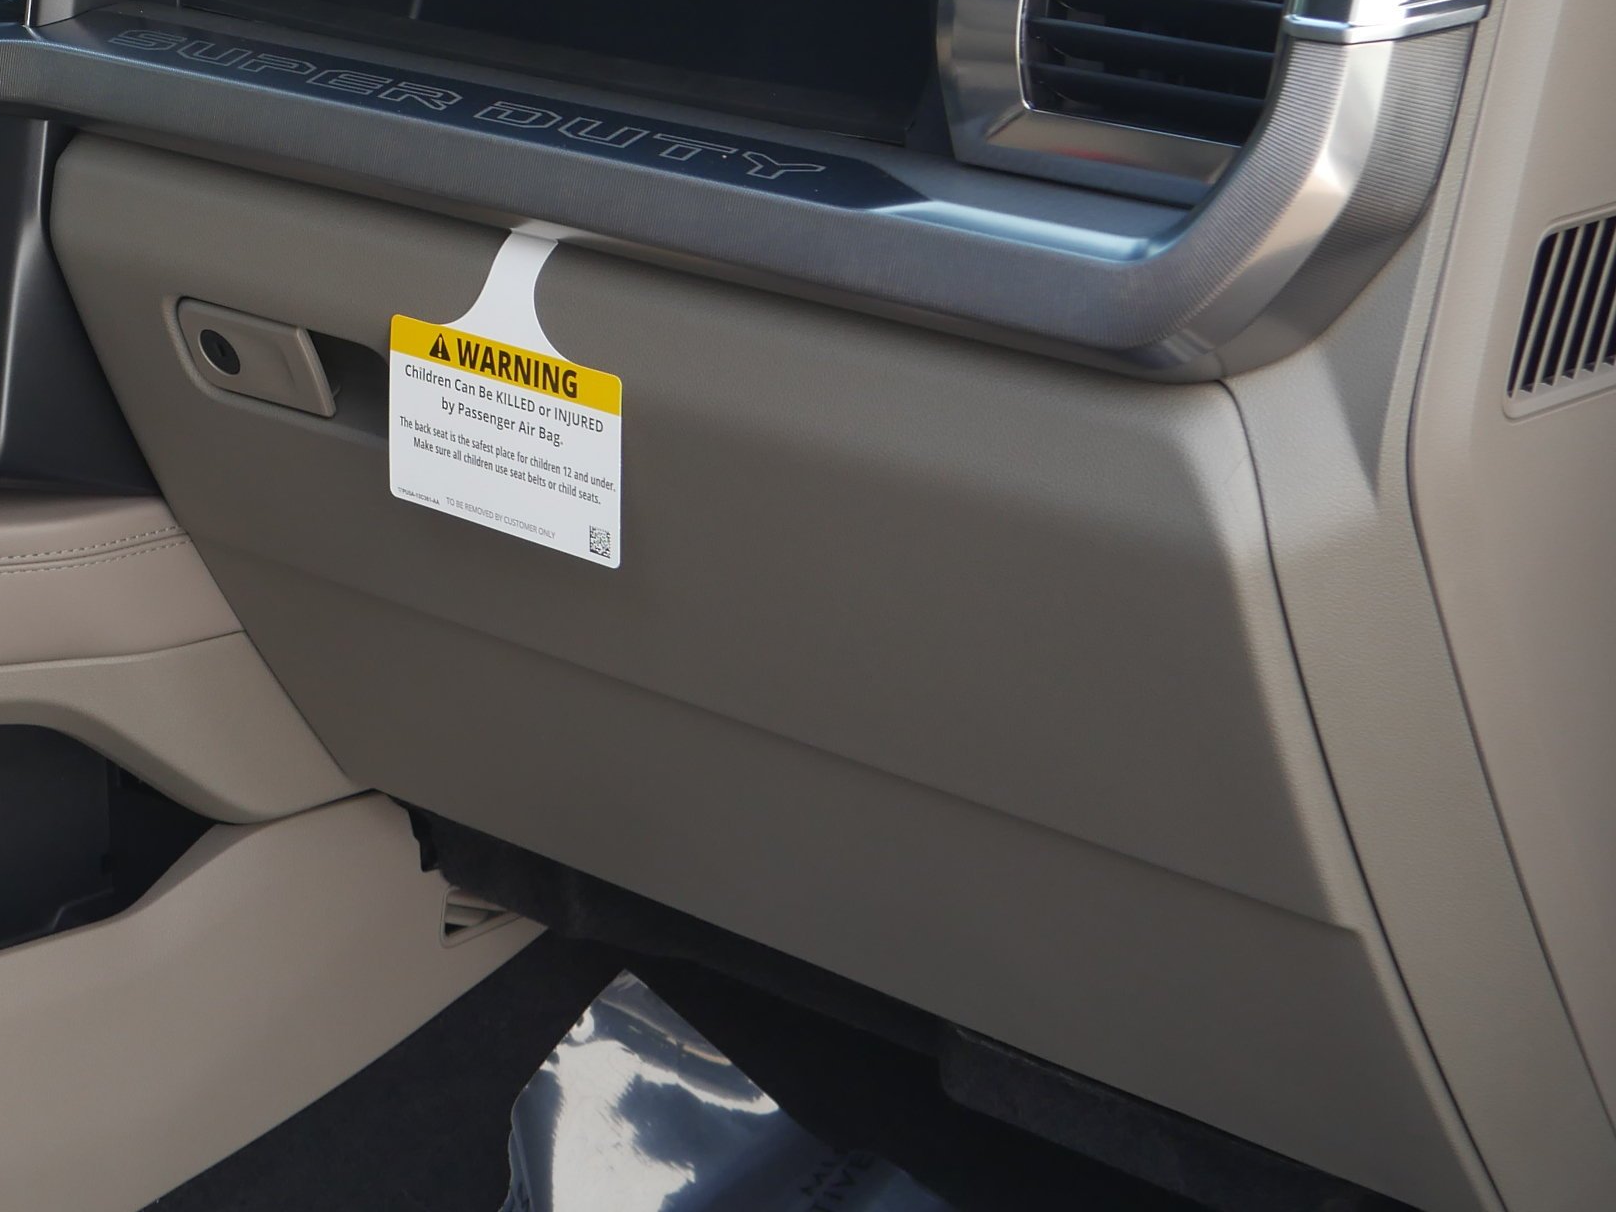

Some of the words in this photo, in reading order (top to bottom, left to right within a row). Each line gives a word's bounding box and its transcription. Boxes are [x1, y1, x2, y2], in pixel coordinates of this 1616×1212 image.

[108, 26, 463, 112] SUPER
[472, 97, 827, 182] DUTY
[404, 364, 451, 389] Children
[454, 378, 476, 396] Can
[479, 385, 493, 401] Be
[496, 390, 535, 413] KILLED
[538, 405, 551, 418] or
[554, 407, 604, 433] INJURED
[456, 337, 578, 399] WARNING
[400, 415, 413, 429] The
[414, 420, 432, 435] back
[433, 427, 449, 441] seat
[450, 431, 456, 443] is
[457, 434, 471, 448] the
[472, 439, 494, 455] safest
[495, 446, 516, 462] place
[517, 451, 528, 464] for
[530, 456, 561, 475] children
[563, 466, 573, 479] 12
[574, 469, 589, 484] and
[590, 477, 616, 493] under.
[441, 396, 455, 416] by
[458, 402, 516, 431] Passenger
[518, 420, 536, 437] Air
[538, 426, 564, 448] Bag.
[413, 436, 434, 453] Make
[435, 444, 451, 458] sure
[453, 450, 462, 462] all
[463, 453, 494, 472] children
[495, 463, 508, 477] use
[510, 467, 526, 482] seat
[527, 471, 546, 488] belts
[547, 480, 557, 491] or
[558, 481, 577, 498] child
[578, 489, 601, 506] seats.
[446, 496, 455, 507] TO
[455, 499, 464, 510] BE
[464, 503, 494, 520] REMOVED
[495, 512, 503, 523] BY
[503, 516, 538, 534] CUSTOMER
[538, 527, 556, 540] ONLY
